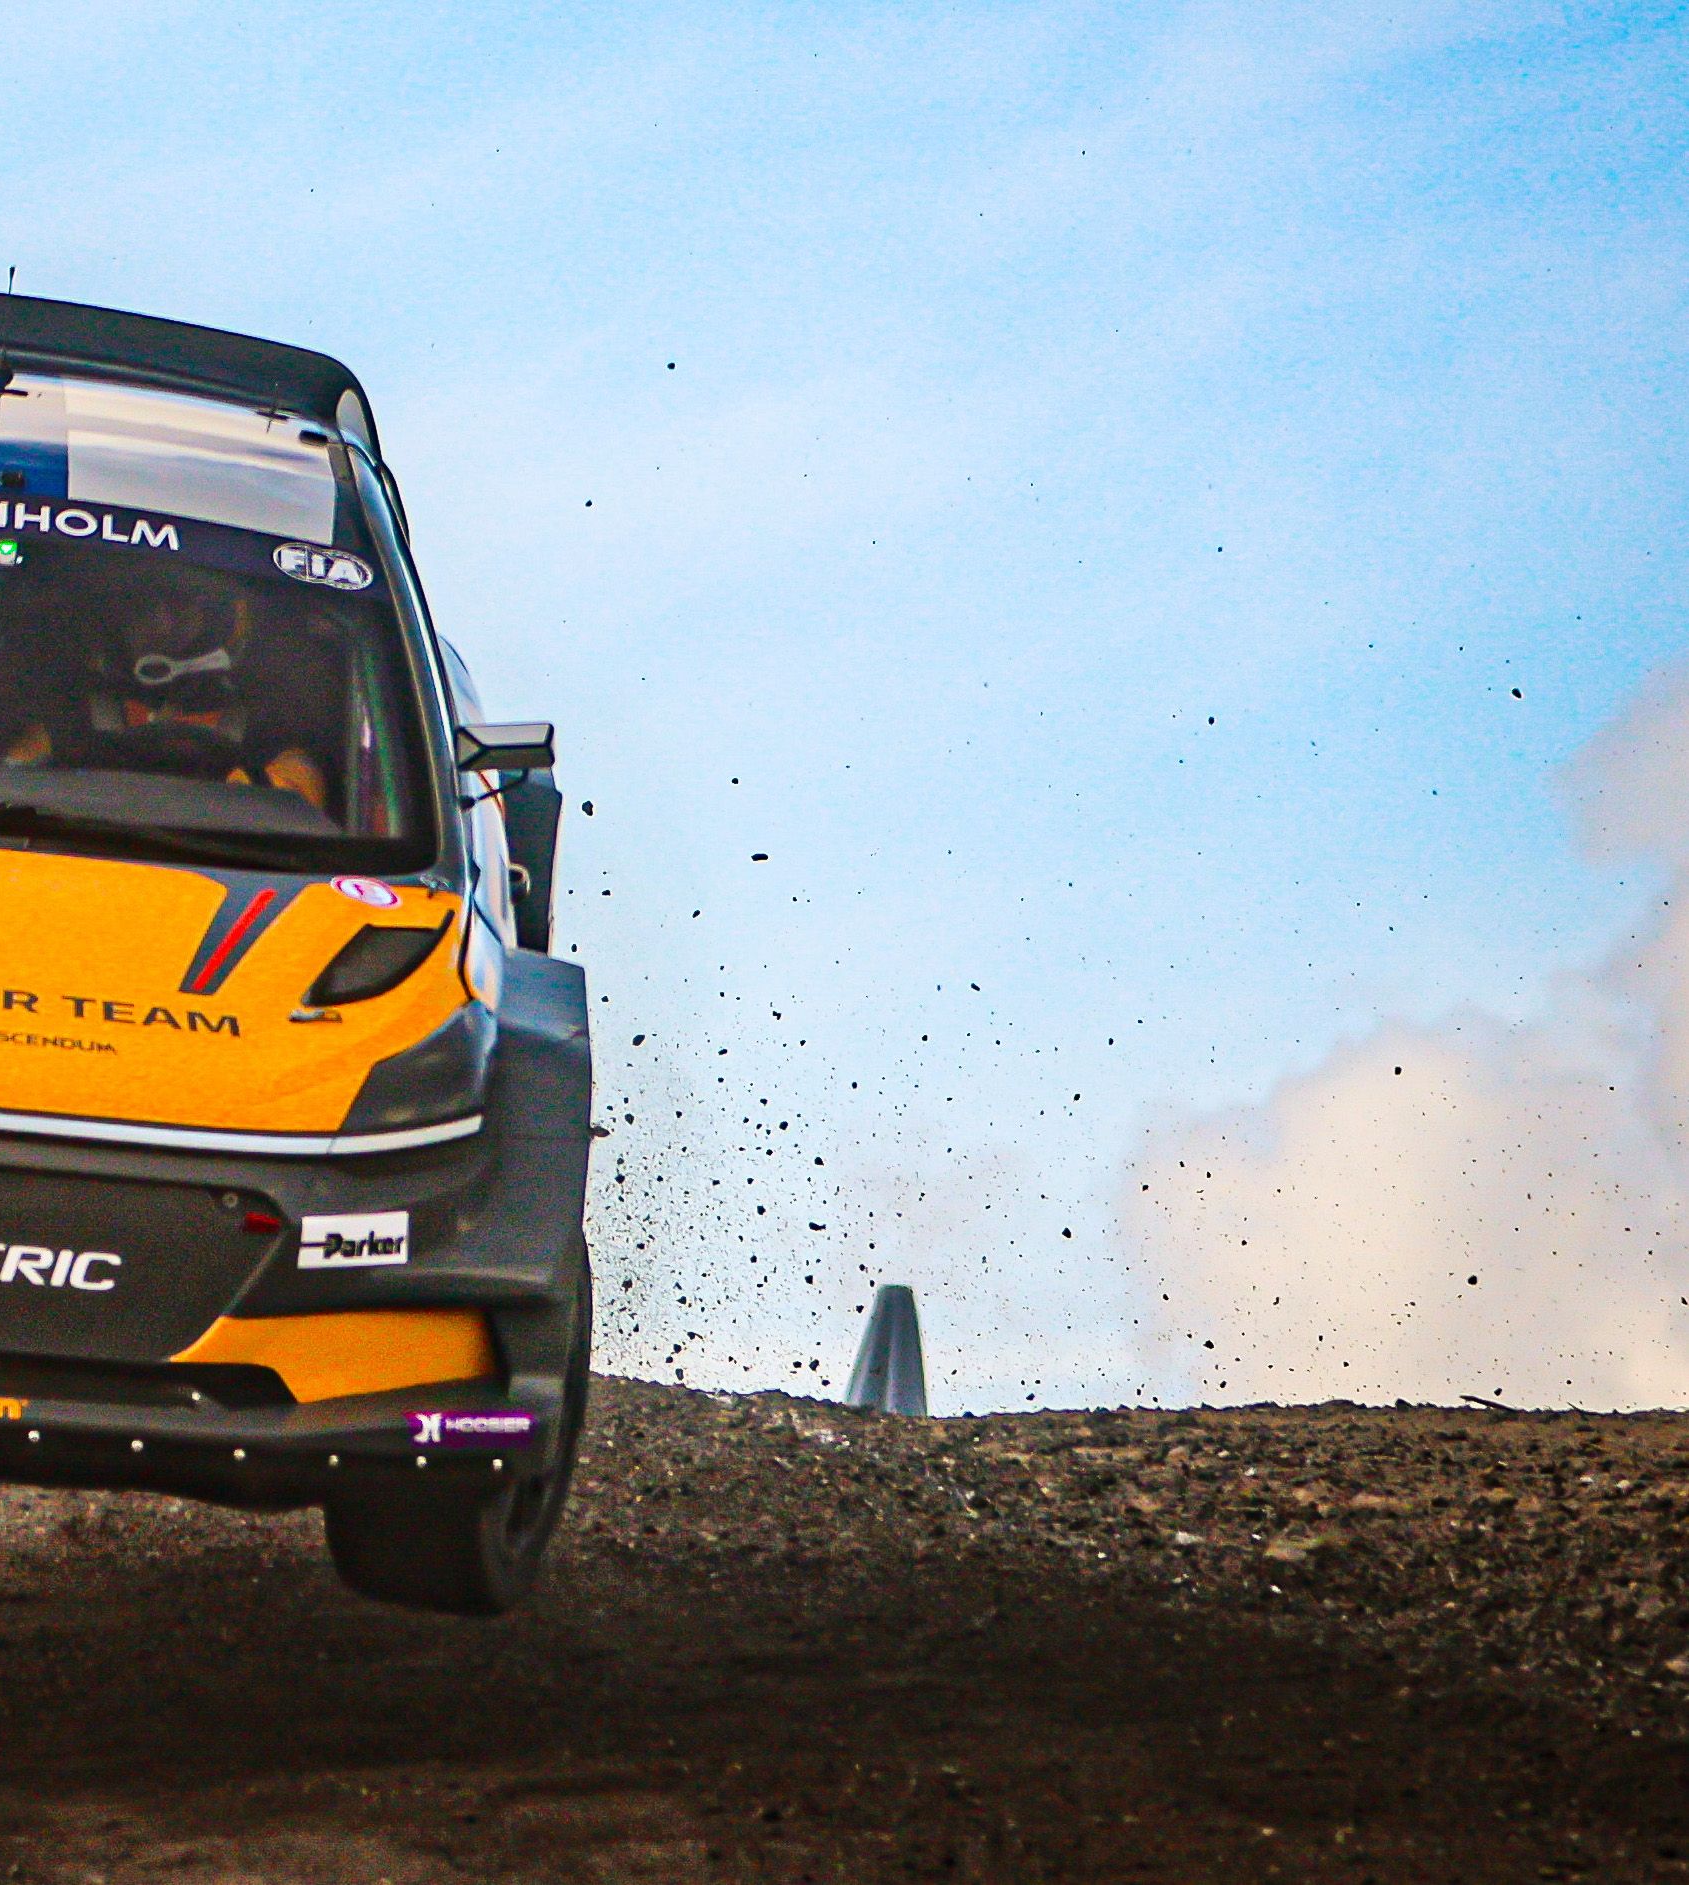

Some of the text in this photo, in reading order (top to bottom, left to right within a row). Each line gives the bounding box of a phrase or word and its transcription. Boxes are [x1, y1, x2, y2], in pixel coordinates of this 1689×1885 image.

[280, 548, 362, 585] FIA
[62, 995, 241, 1037] TEAM
[322, 1231, 404, 1259] Parker
